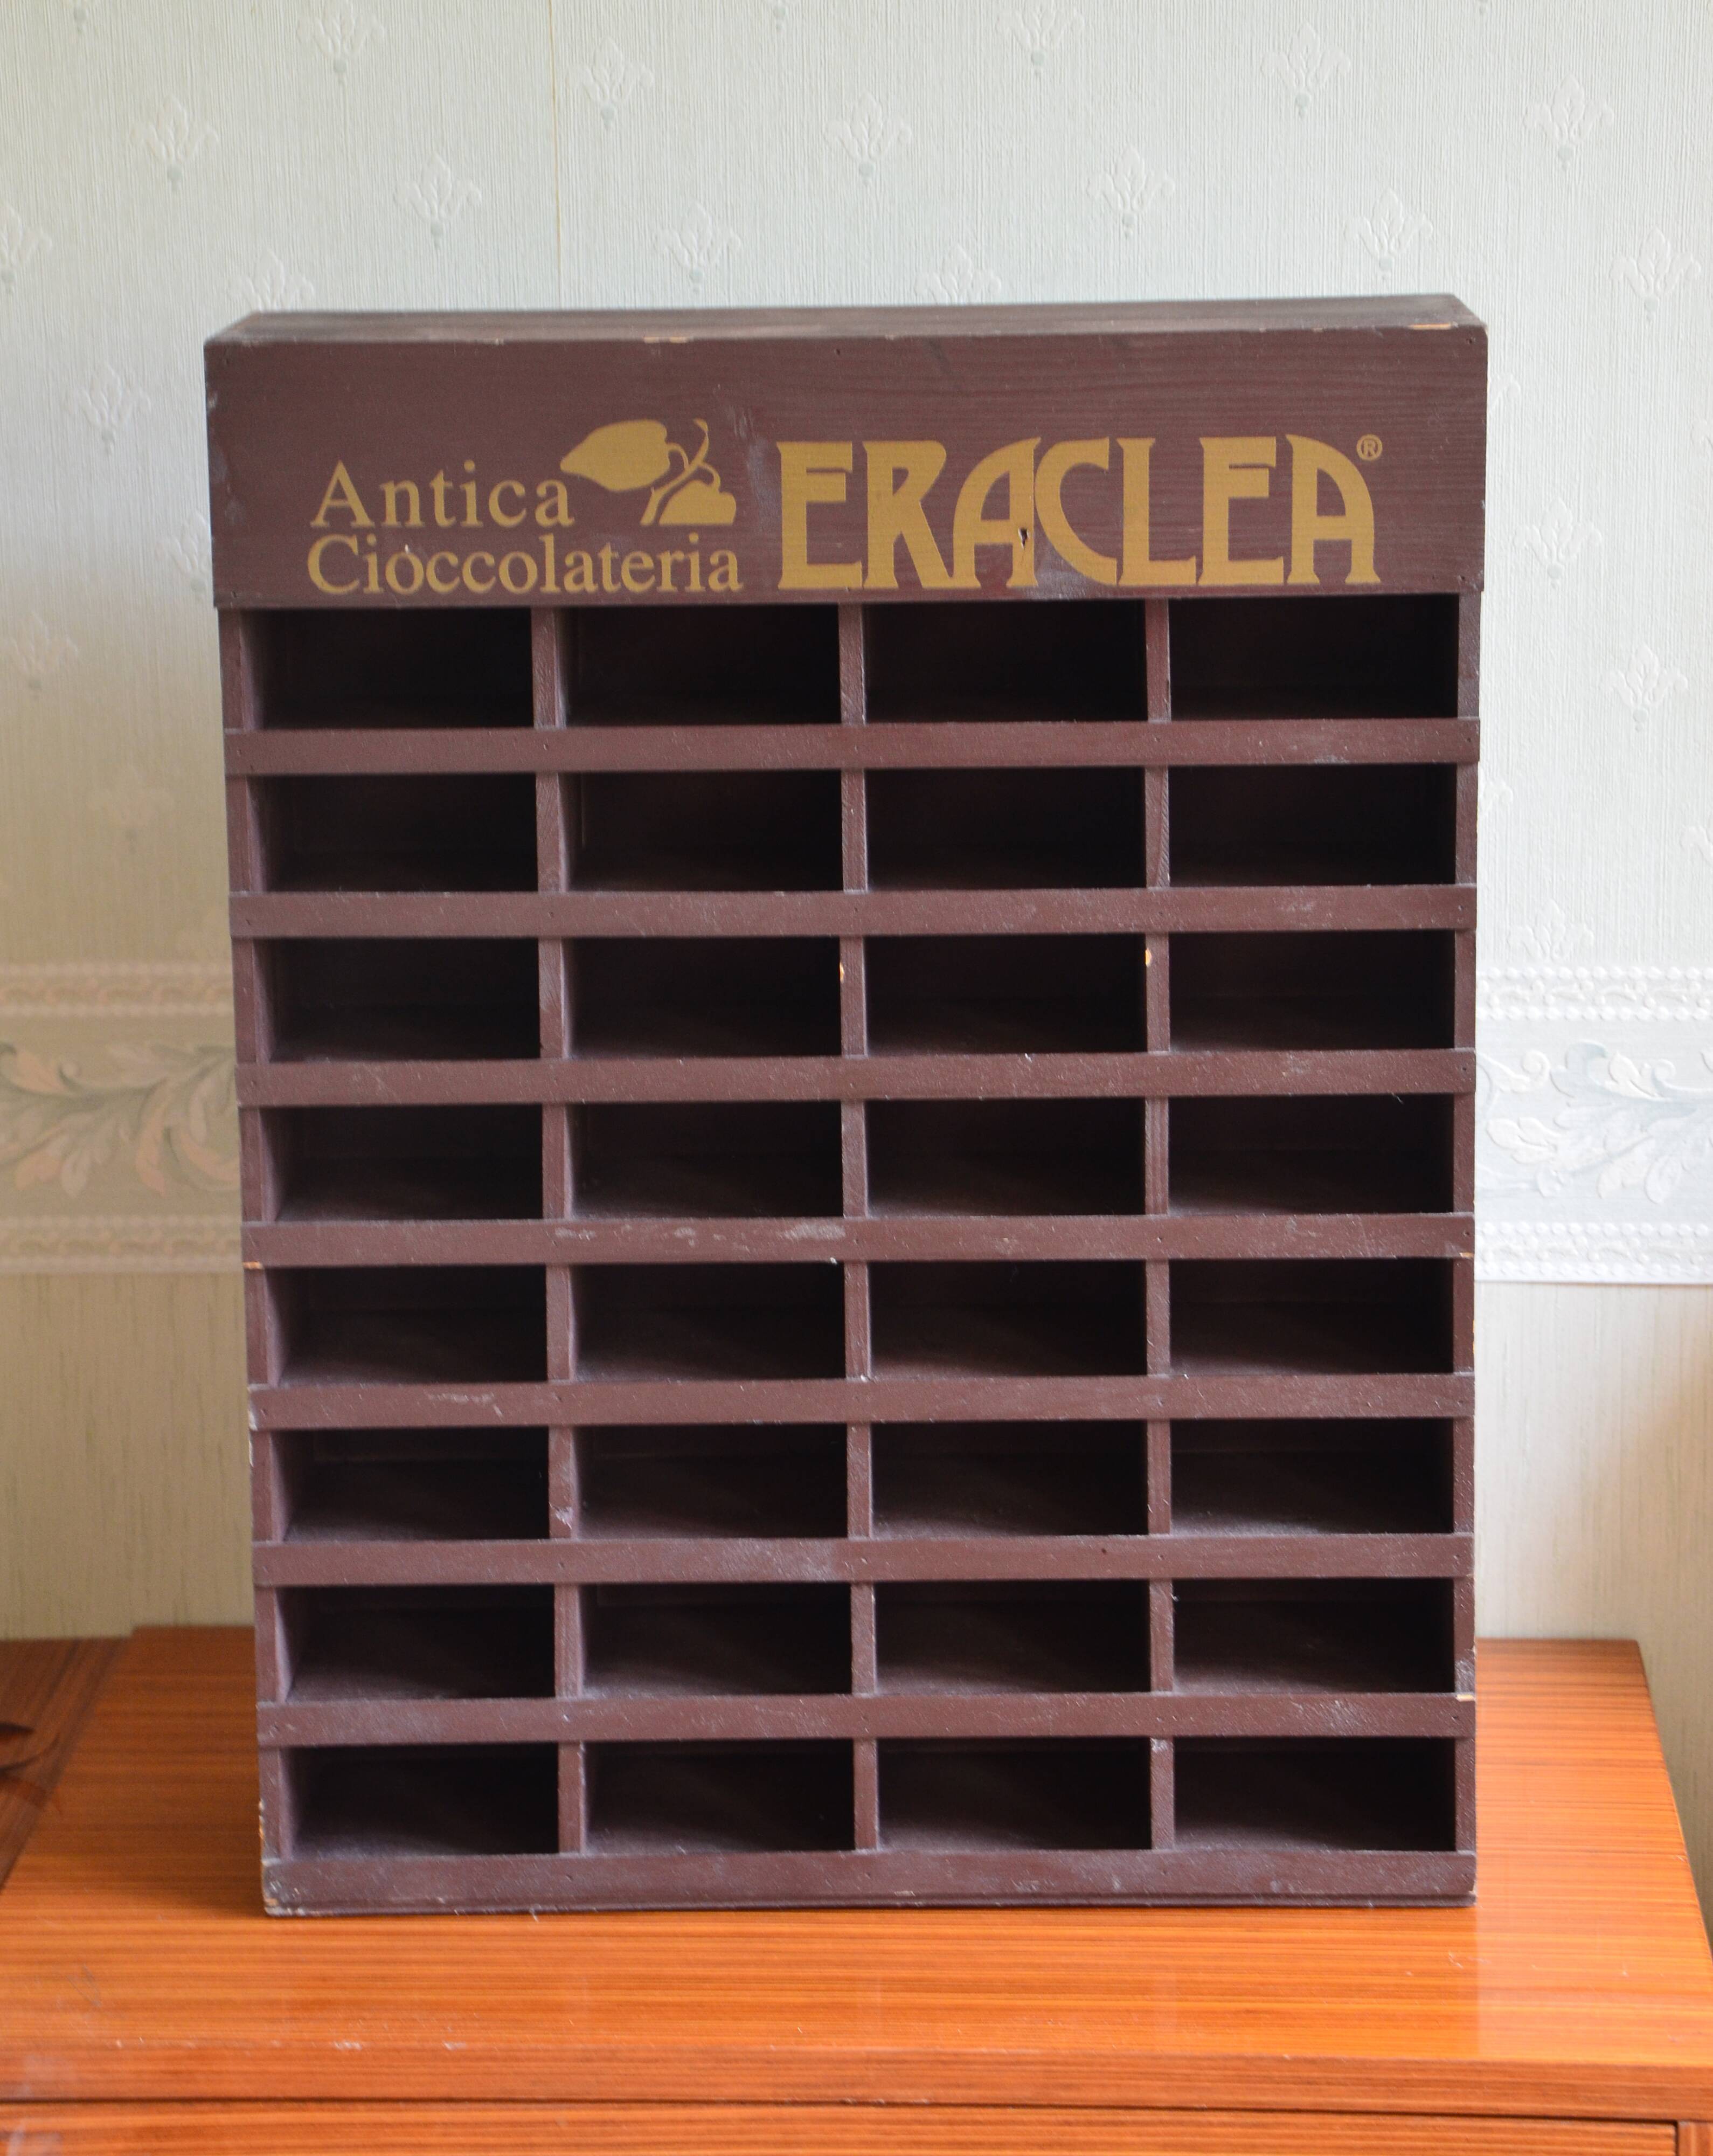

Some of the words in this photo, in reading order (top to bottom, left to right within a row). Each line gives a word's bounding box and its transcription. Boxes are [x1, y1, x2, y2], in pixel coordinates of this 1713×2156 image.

[309, 459, 575, 528] Antica
[775, 433, 1382, 591] ERACLEA
[306, 531, 743, 594] Cioccolateria
